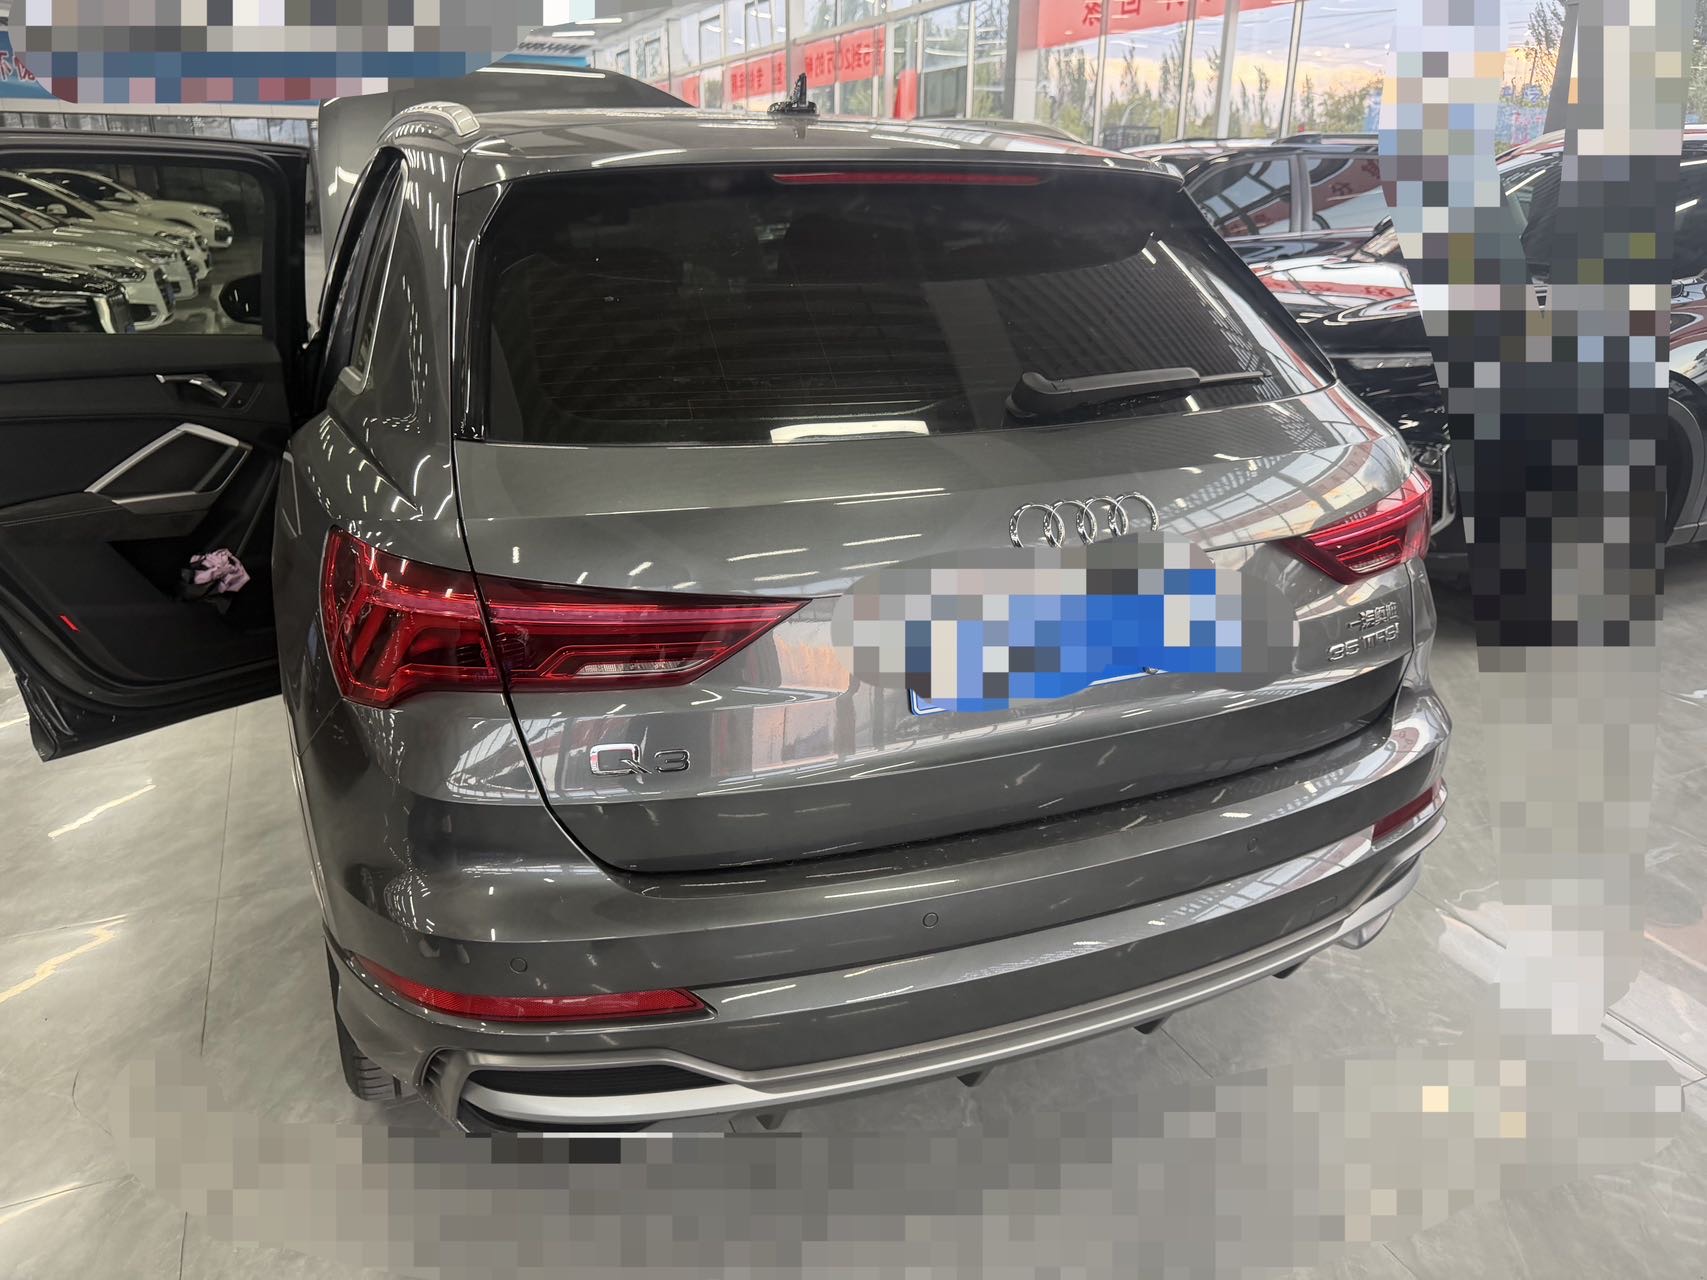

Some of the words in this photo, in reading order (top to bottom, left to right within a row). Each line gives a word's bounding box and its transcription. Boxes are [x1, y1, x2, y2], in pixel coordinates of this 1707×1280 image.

[1328, 638, 1360, 661] 35
[1361, 622, 1399, 648] TFSI
[589, 743, 690, 777] Q3
